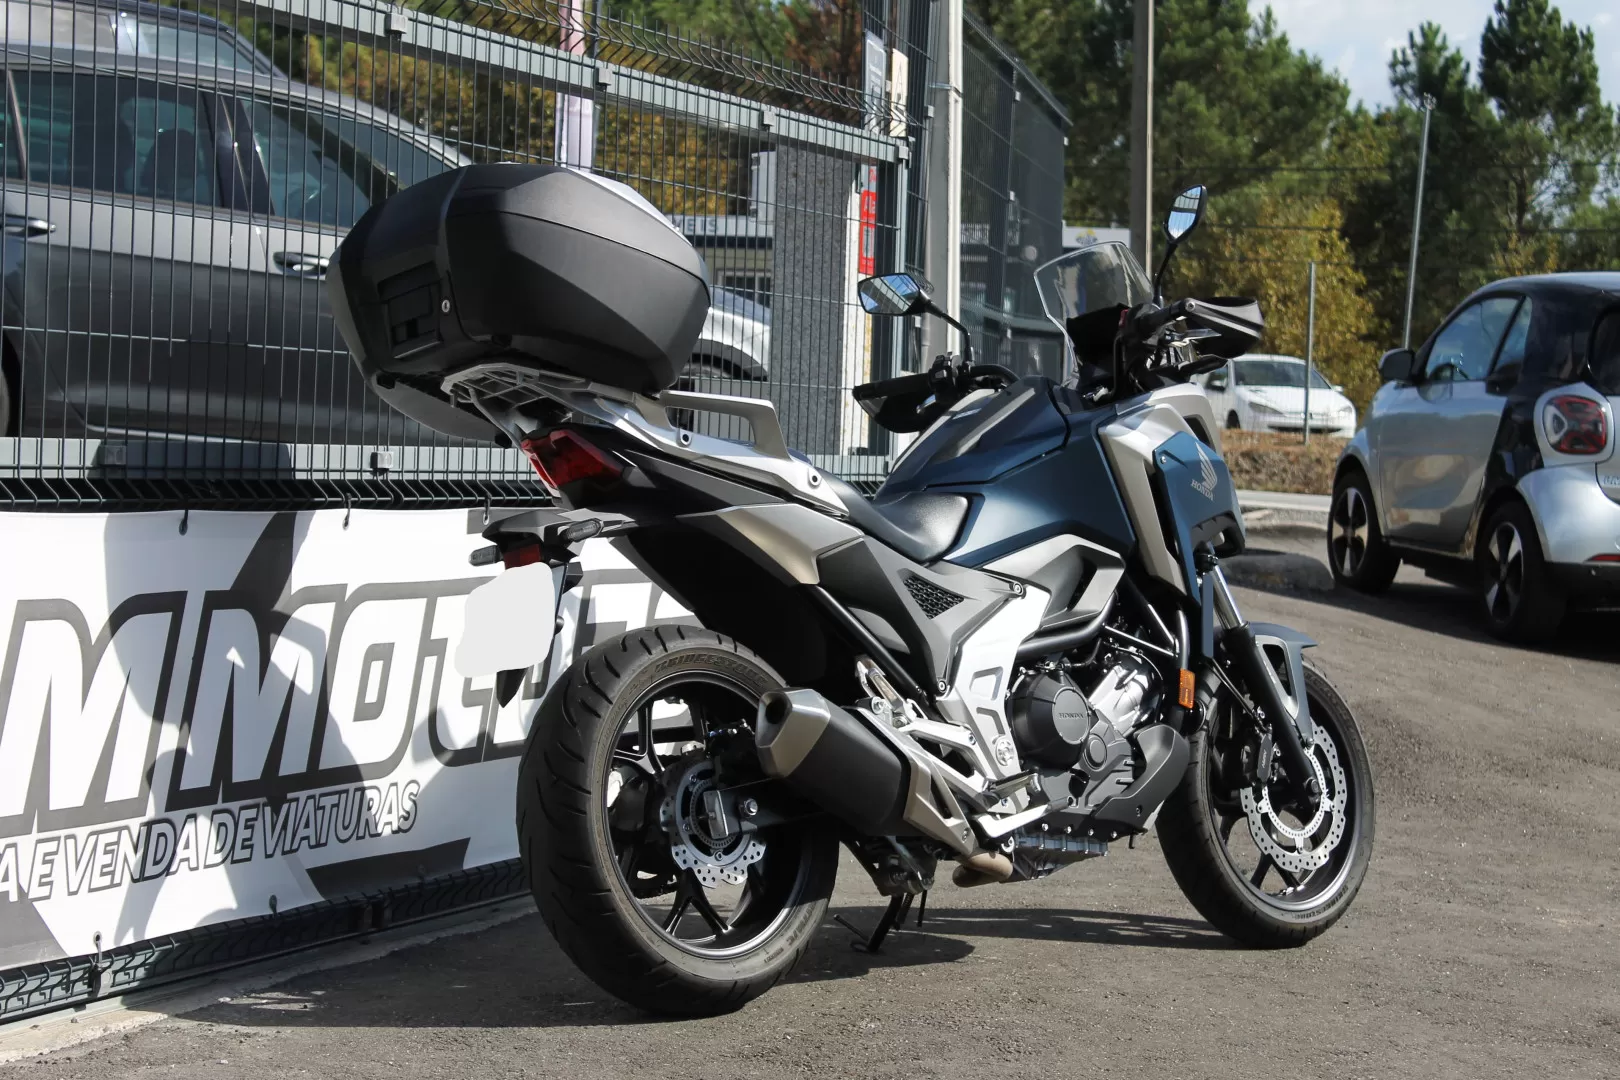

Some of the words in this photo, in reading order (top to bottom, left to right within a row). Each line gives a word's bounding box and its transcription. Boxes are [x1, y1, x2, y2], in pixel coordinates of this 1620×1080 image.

[1191, 479, 1214, 502] HONDA
[26, 834, 61, 902] E
[63, 812, 200, 897] VENDA
[202, 801, 262, 870] DE
[260, 778, 421, 859] VIATURAS
